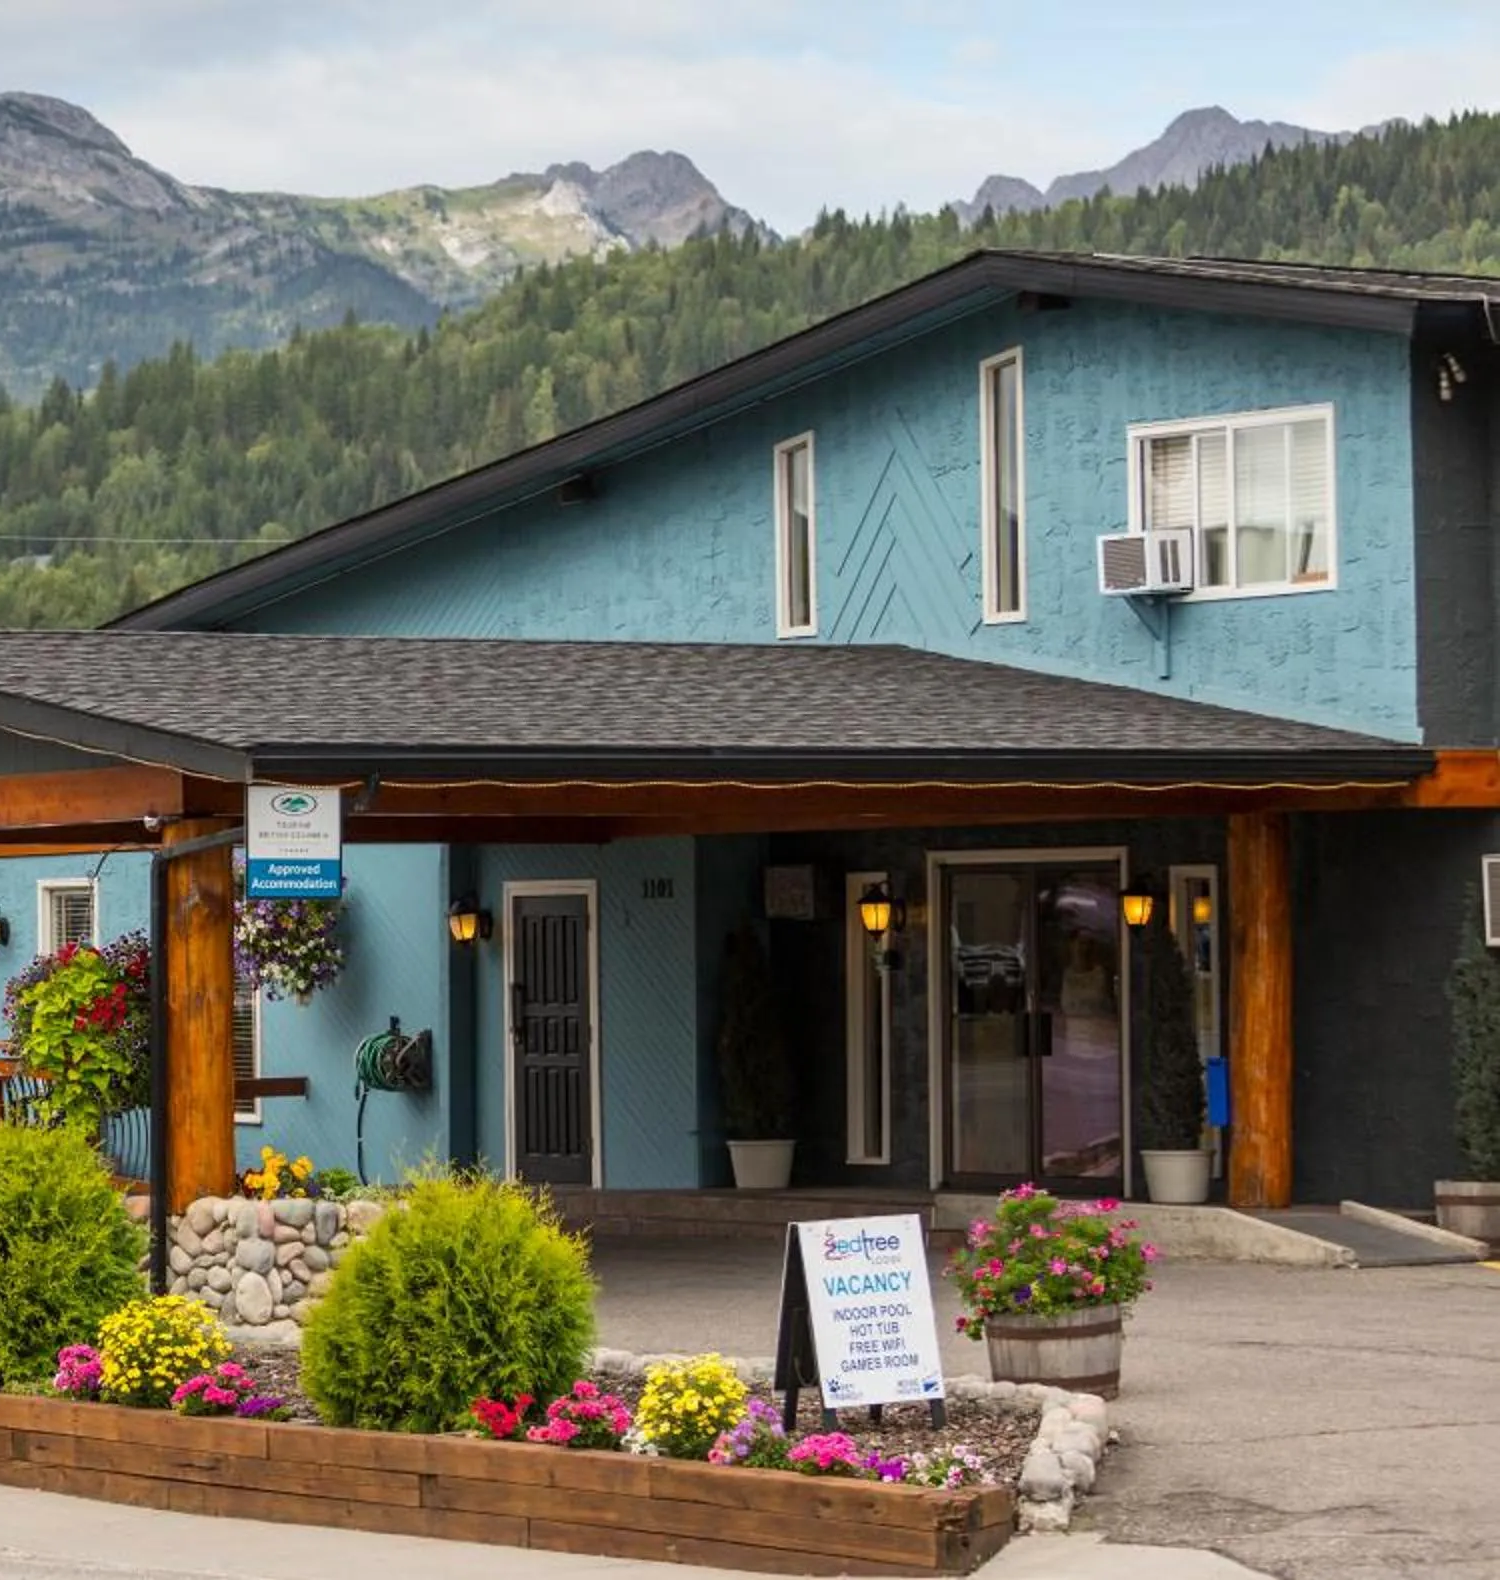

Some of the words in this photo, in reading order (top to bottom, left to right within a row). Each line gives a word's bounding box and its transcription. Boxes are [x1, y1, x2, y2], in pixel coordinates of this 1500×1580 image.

[268, 864, 321, 877] Approved
[251, 877, 337, 889] Accommodation
[823, 1270, 912, 1297] VACANCY
[833, 1306, 877, 1321] INDOOR
[880, 1303, 912, 1317] POOL
[849, 1323, 873, 1337] HOT
[876, 1321, 900, 1335] TUB
[849, 1340, 880, 1355] FREE
[882, 1337, 906, 1351] WIFI
[840, 1357, 882, 1373] GAMES
[885, 1352, 919, 1368] ROOM
